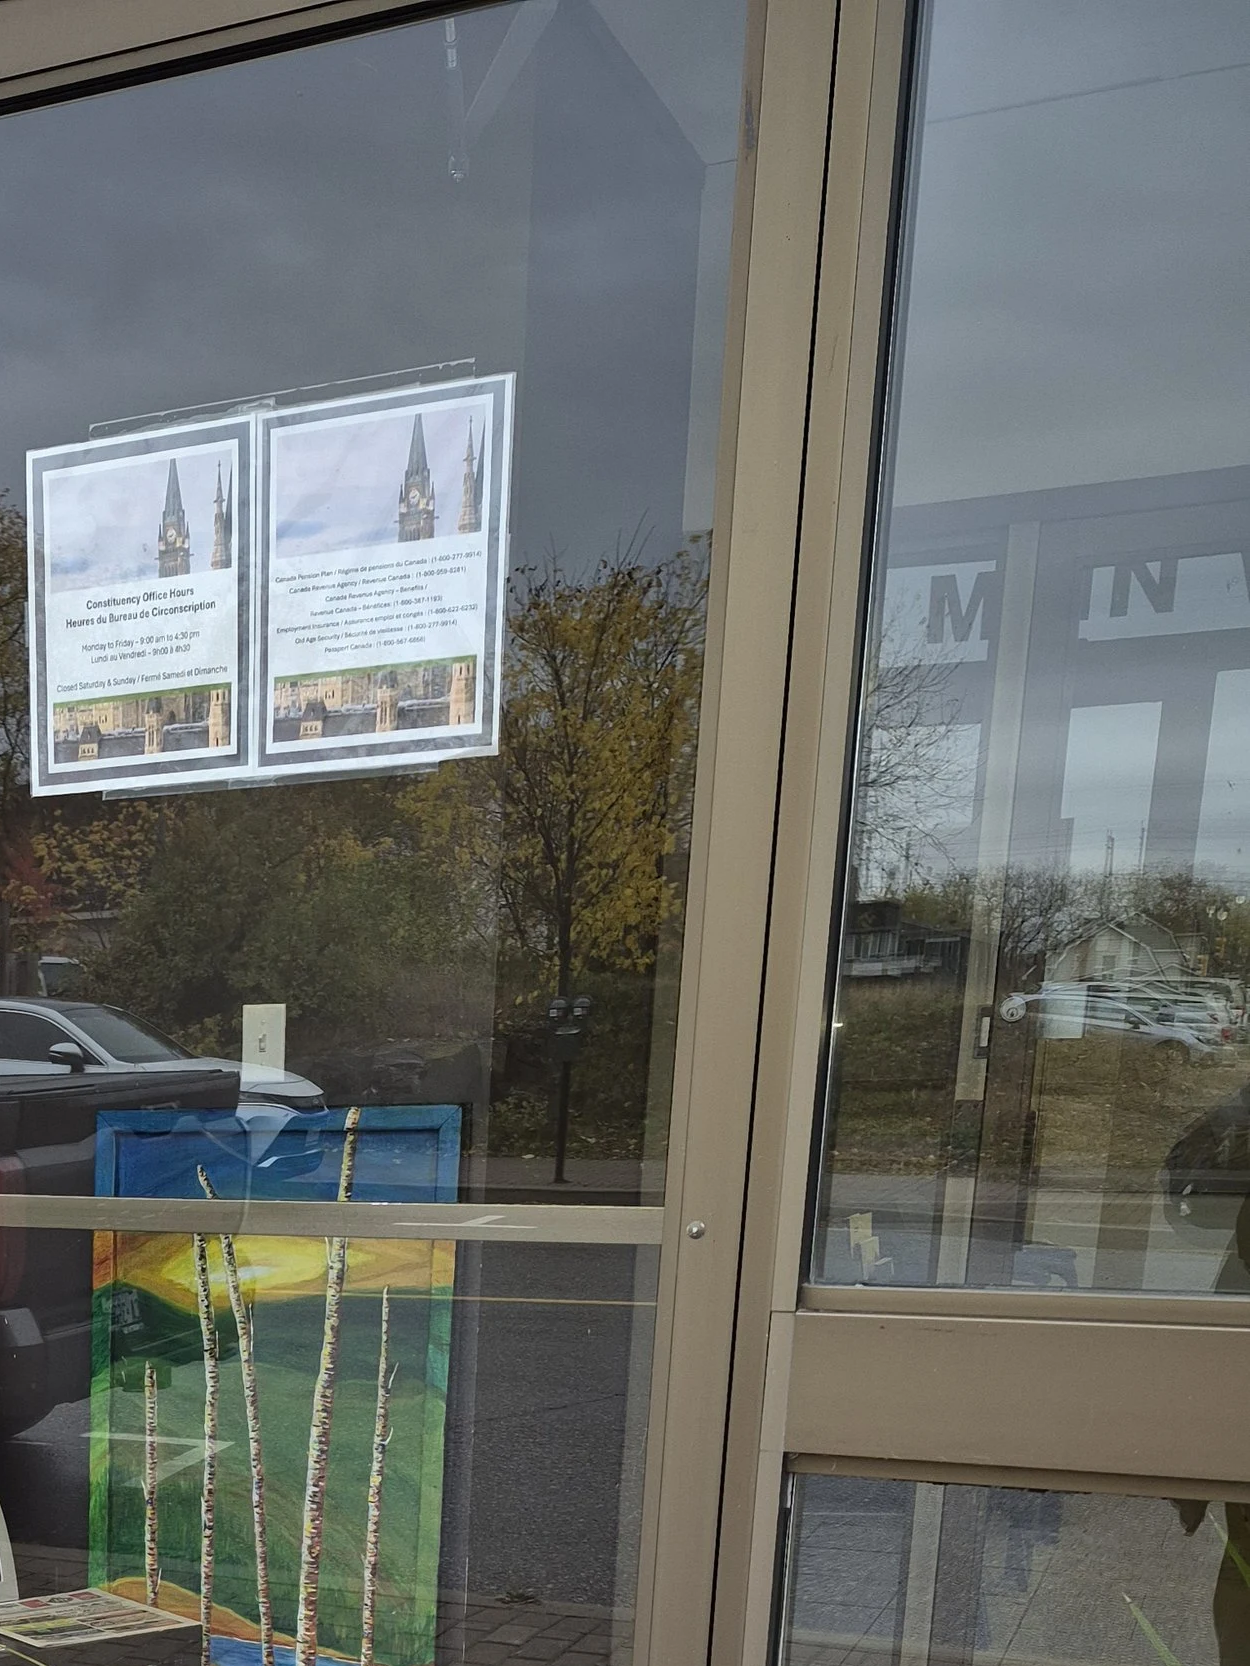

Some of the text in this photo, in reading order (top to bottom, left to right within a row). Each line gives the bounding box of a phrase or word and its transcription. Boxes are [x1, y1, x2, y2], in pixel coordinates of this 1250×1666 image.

[87, 587, 194, 610] Constituency Office Hours
[66, 600, 216, 628] Heures du Bureau de Circonscription
[82, 630, 200, 652] Monday to Friday 9:00 am to 4:30 pm
[91, 653, 108, 664] Lundi
[110, 653, 118, 662] au
[119, 649, 146, 661] Vendredi
[153, 647, 168, 656] 9h00
[175, 644, 190, 653] 4h30
[57, 682, 78, 693] Closed
[79, 679, 105, 690] Saturday
[107, 679, 111, 687] &
[113, 675, 136, 687] Sunday
[141, 672, 161, 682] Fermé
[163, 670, 185, 680] Samedi
[187, 669, 193, 677] et
[195, 665, 228, 676] Dimanche
